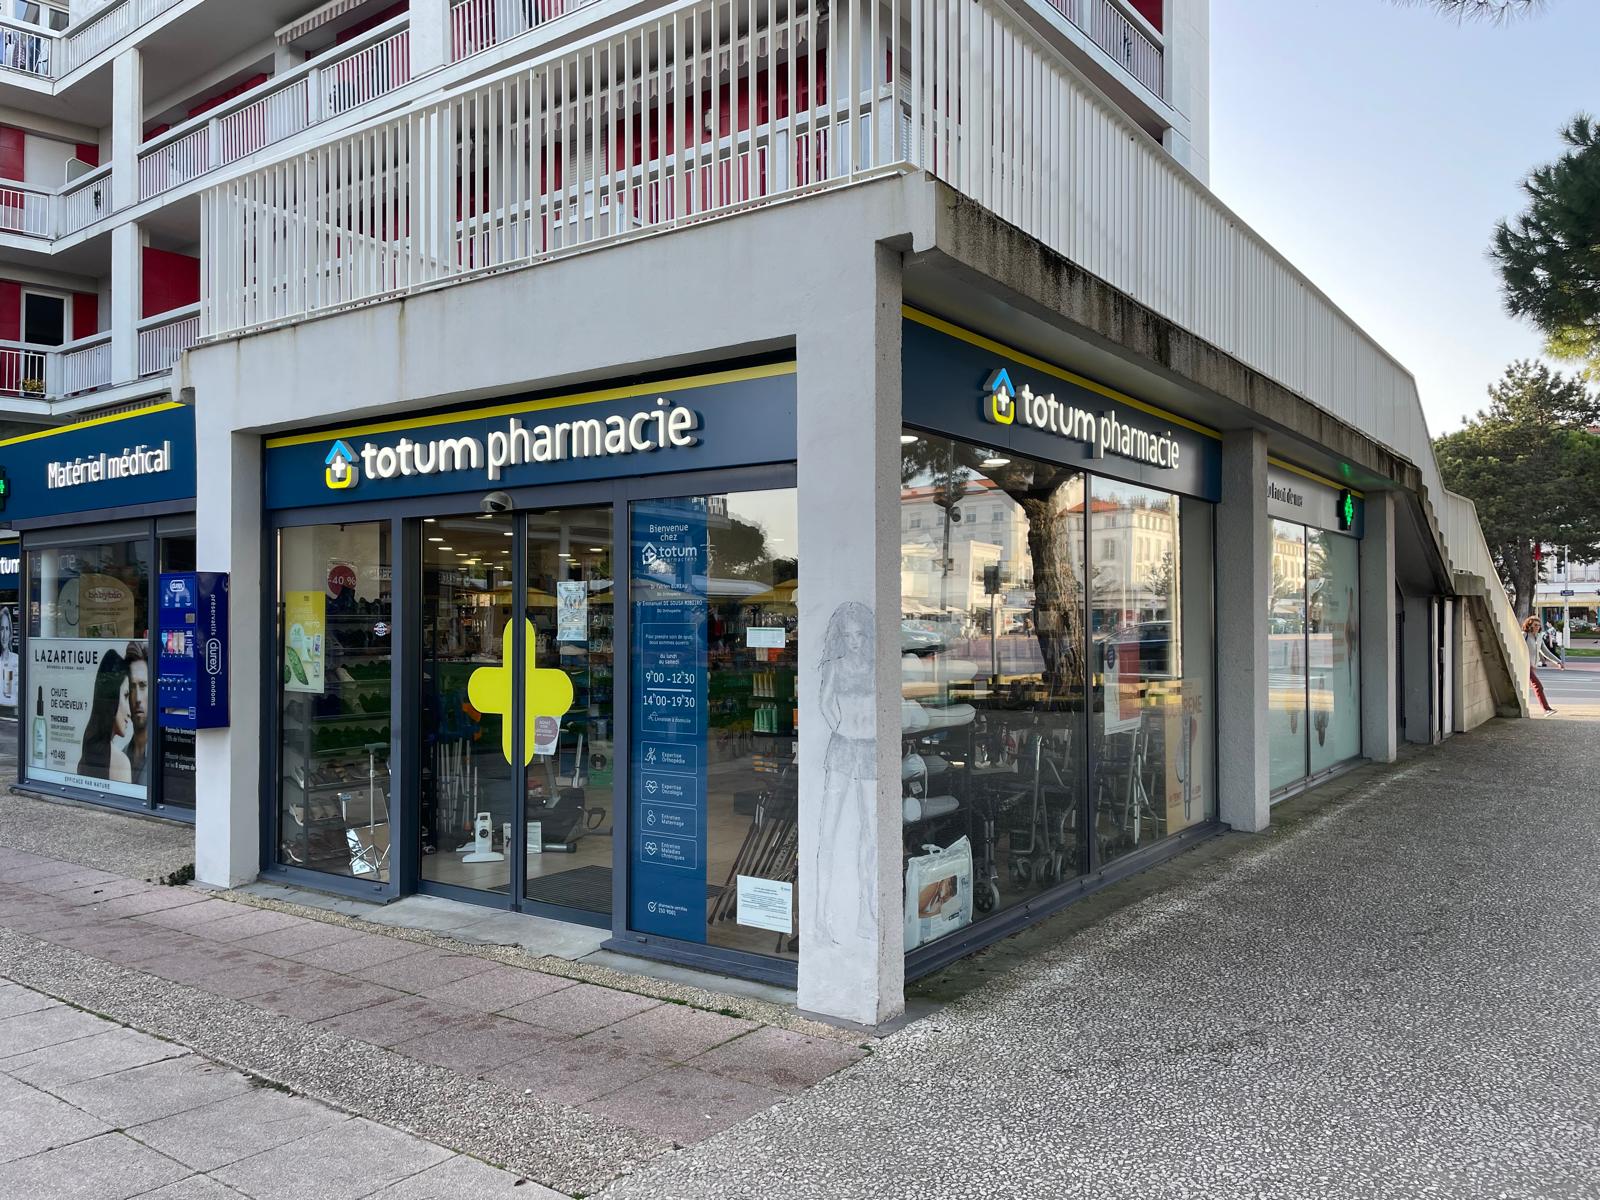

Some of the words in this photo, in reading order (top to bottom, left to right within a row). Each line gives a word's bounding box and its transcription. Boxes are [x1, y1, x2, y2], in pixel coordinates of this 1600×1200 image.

[1018, 383, 1096, 444] totum
[1099, 411, 1179, 470] pharmacie
[361, 436, 483, 480] totum
[487, 397, 699, 481] pharmacie
[48, 453, 106, 489] Matériel
[108, 440, 170, 480] médical
[649, 524, 689, 533] Bienvenue
[660, 533, 678, 541] chez
[659, 546, 697, 557] totum
[34, 648, 98, 665] LAZARTIGUE
[209, 641, 219, 671] durex
[50, 688, 68, 698] CHUTE
[50, 699, 58, 708] DE
[59, 699, 83, 710] CHEVEUX
